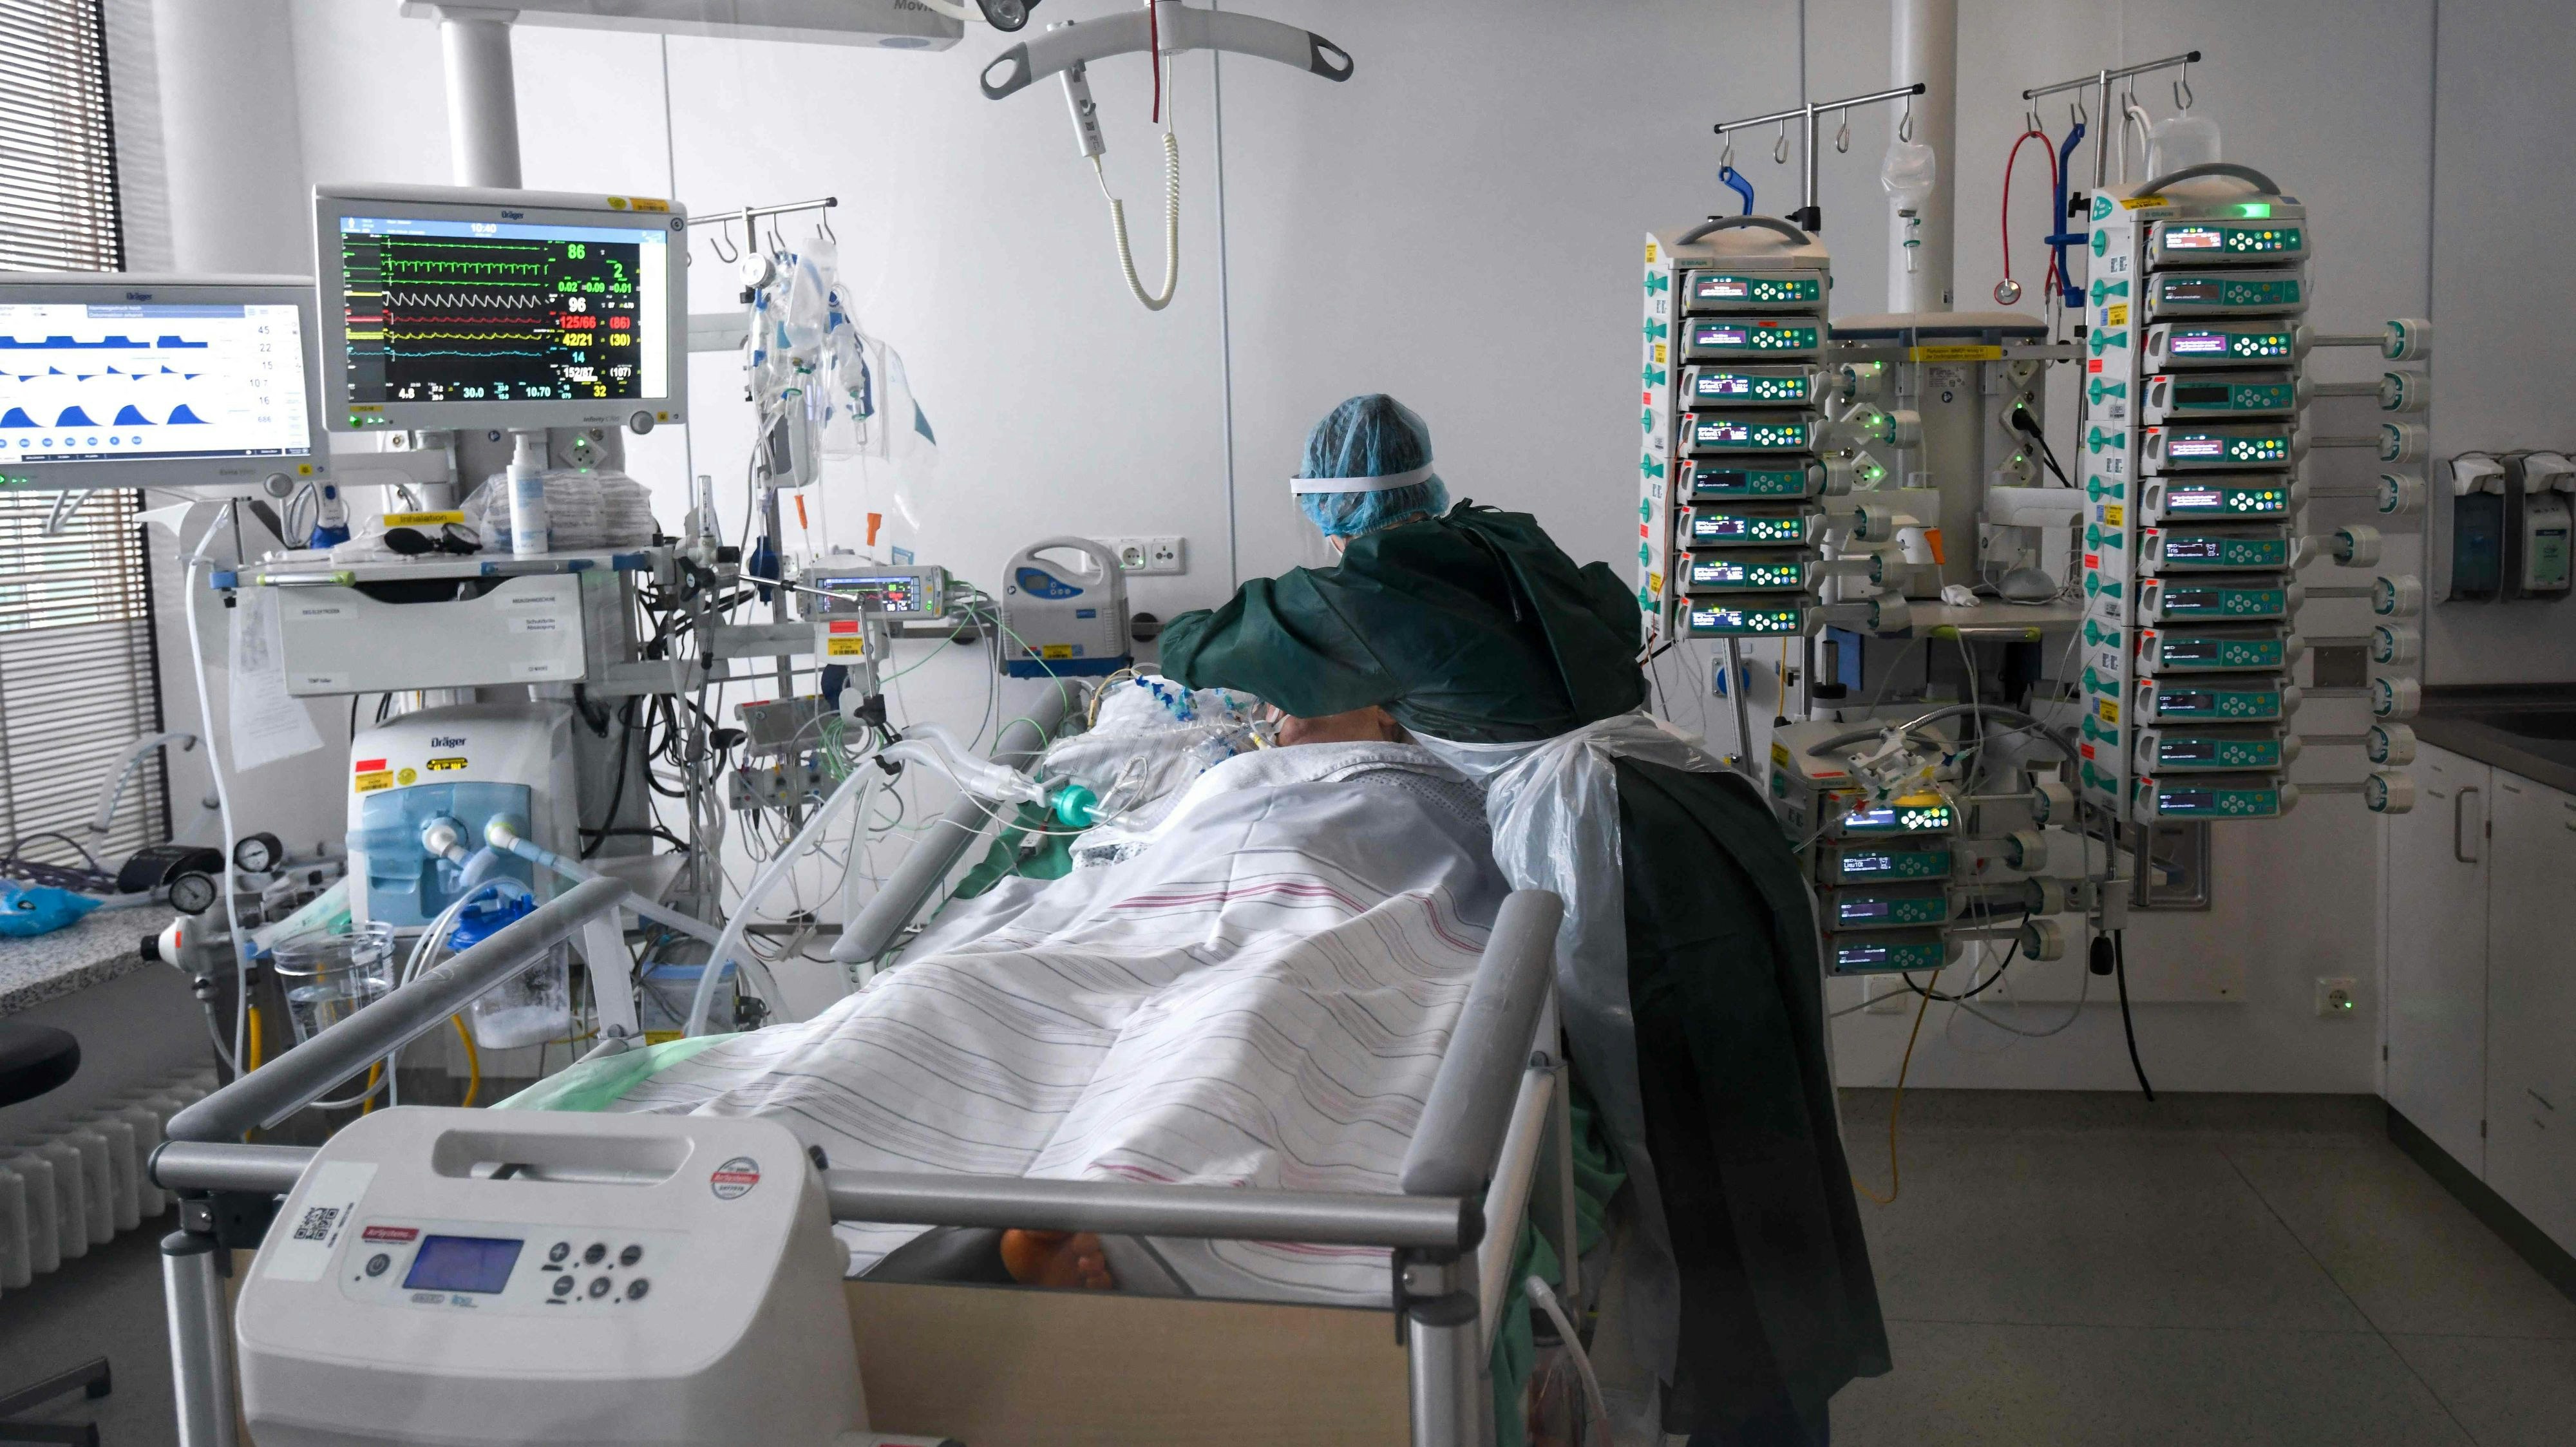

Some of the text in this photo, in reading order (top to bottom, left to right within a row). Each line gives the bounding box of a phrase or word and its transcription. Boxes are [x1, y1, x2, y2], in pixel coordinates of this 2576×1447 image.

[471, 223, 497, 233] 10:40
[567, 243, 585, 259] 86
[614, 263, 623, 278] 2
[568, 297, 586, 312] 96
[560, 316, 630, 329] 125/66 (86)
[258, 326, 270, 334] 45
[562, 334, 630, 346] 42/21 (30)
[260, 343, 271, 352] 22
[572, 352, 585, 363] 14
[263, 361, 272, 370] 15
[610, 367, 631, 377] (107)
[398, 385, 607, 399] 4,8 30,0 10,70 32
[260, 396, 270, 404] 16
[401, 514, 447, 522] Inhalation
[431, 736, 467, 748] Dräger
